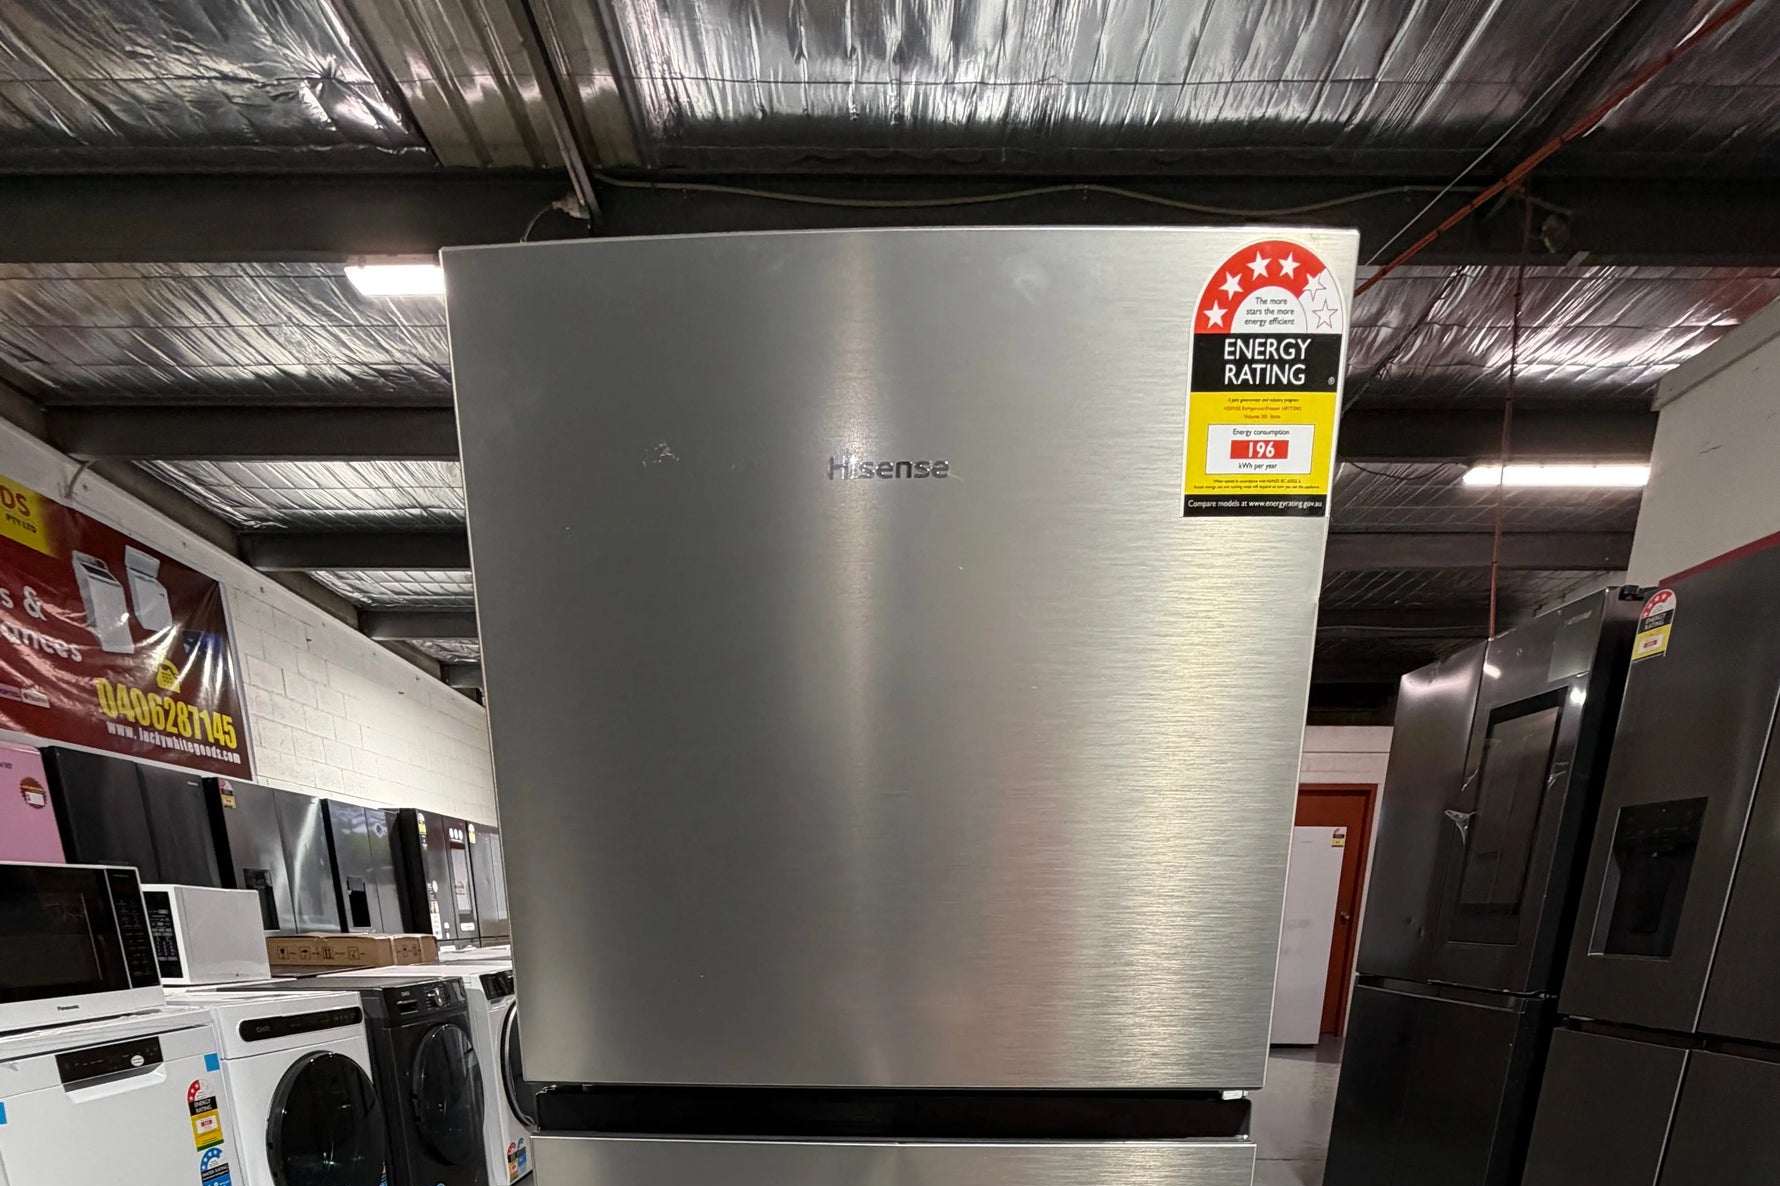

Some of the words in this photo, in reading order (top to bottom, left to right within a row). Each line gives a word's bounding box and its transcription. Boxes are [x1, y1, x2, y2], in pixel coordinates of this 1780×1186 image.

[1255, 296, 1269, 305] The
[1246, 308, 1263, 316] stars
[1264, 307, 1276, 316] the
[1276, 308, 1295, 316] more
[1244, 318, 1267, 328] energy
[1268, 317, 1295, 326] efficient
[1223, 338, 1312, 361] ENERGY
[1224, 363, 1307, 386] RATING
[1232, 428, 1252, 437] Energy
[1253, 429, 1290, 437] consumption
[1248, 441, 1275, 458] 196
[827, 456, 949, 480] Hisense
[1253, 463, 1264, 471] per
[1187, 499, 1216, 509] Compare
[1217, 499, 1240, 507] models
[1248, 500, 1323, 509] www.energyrating.gov.au
[23, 585, 48, 621] &
[96, 677, 238, 750] 0406287145
